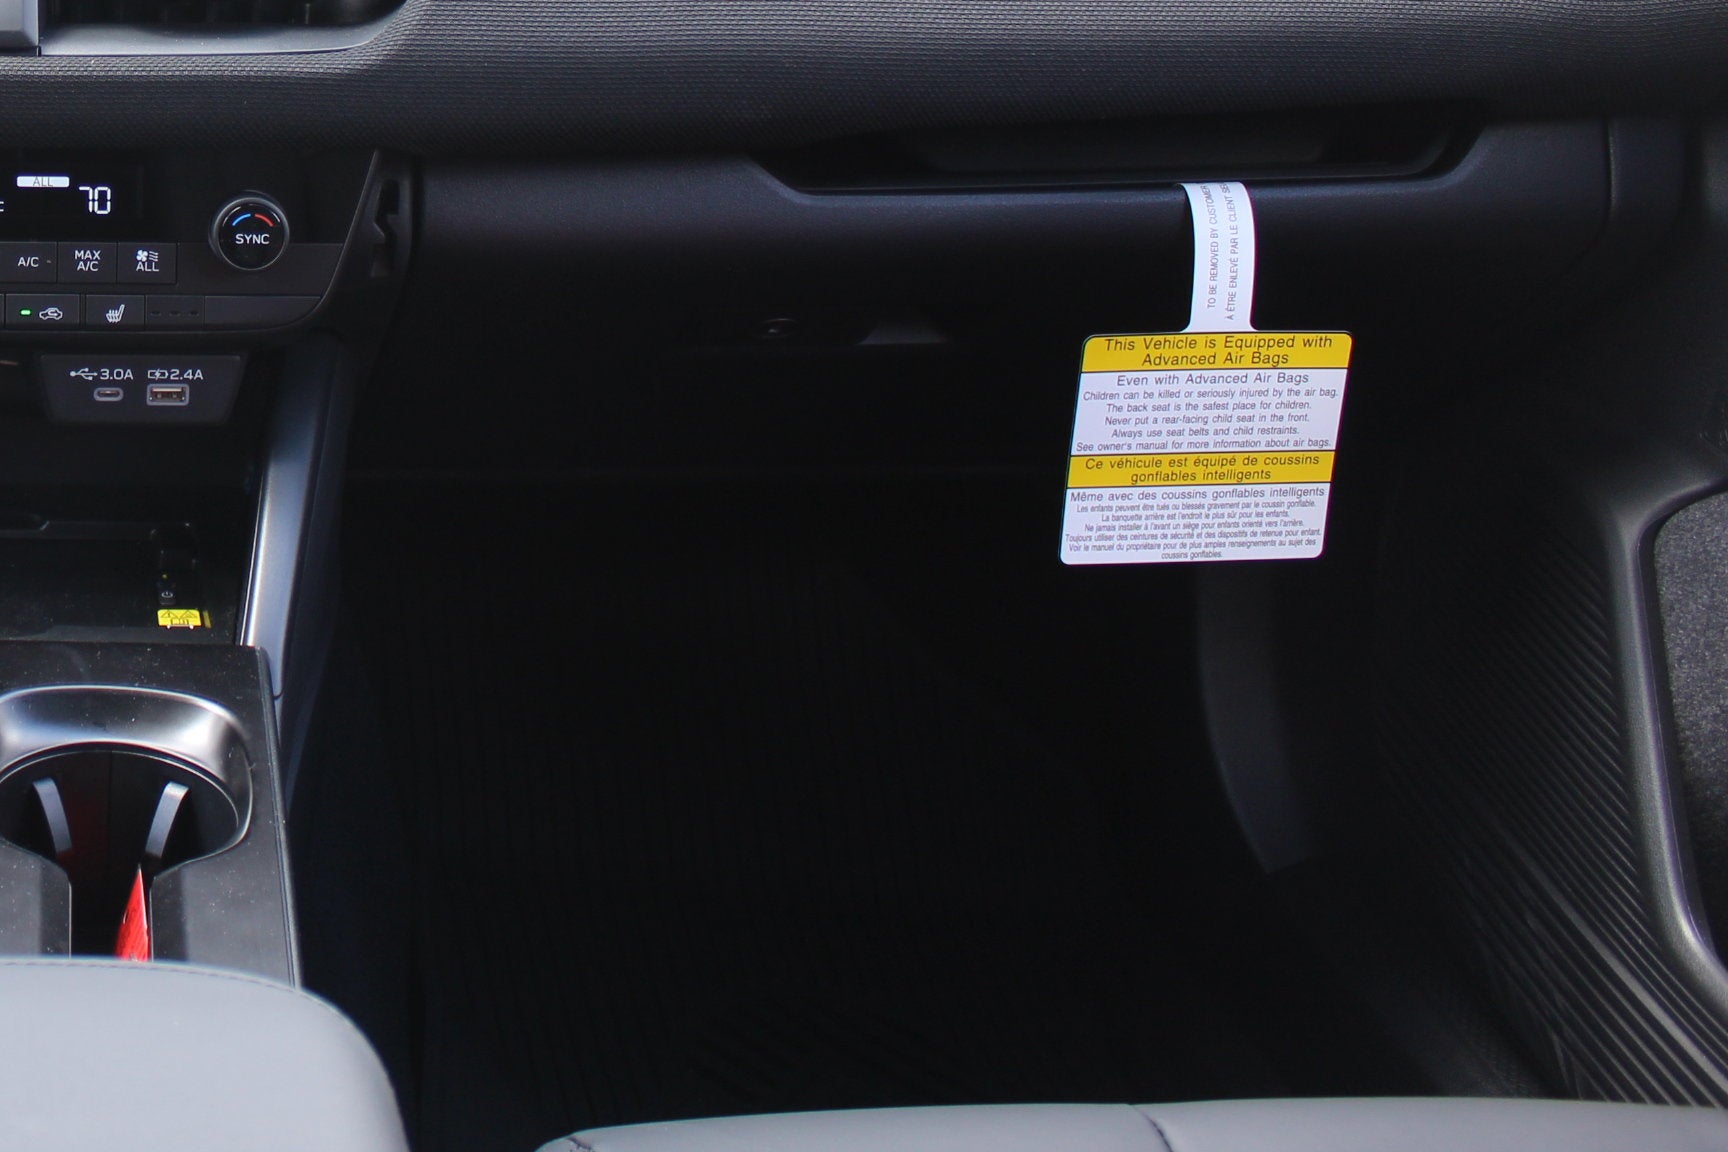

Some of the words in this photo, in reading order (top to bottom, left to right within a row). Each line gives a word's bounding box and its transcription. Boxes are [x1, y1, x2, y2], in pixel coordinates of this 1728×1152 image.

[32, 176, 54, 186] ALL
[78, 186, 111, 215] 70
[1224, 196, 1238, 222] CLIENT
[1208, 228, 1219, 238] BY
[1230, 224, 1238, 235] LE
[235, 234, 270, 245] SYNC
[1230, 238, 1240, 254] PAR
[74, 250, 101, 260] MAX
[1210, 241, 1219, 282] REMOVED
[18, 256, 39, 268] A/C
[76, 260, 98, 272] A/C
[136, 262, 160, 272] ALL
[1208, 284, 1217, 295] BE
[1207, 297, 1216, 309] TO
[1105, 338, 1135, 350] This
[1144, 337, 1197, 349] Vehicle
[1205, 337, 1216, 349] is
[1224, 336, 1295, 351] Equipped
[1303, 335, 1332, 348] with
[1142, 353, 1216, 366] Advanced
[1223, 352, 1245, 364] Air
[1251, 352, 1288, 367] Bags
[100, 368, 134, 380] 3.0A
[170, 368, 204, 380] 2.4A
[1117, 375, 1148, 386] Even
[1155, 374, 1179, 385] with
[1185, 373, 1248, 384] Advanced
[1254, 372, 1272, 383] Air
[1277, 372, 1309, 385] Bags
[1083, 391, 1120, 400] Children
[1123, 392, 1139, 400] can
[1142, 390, 1154, 399] be
[1158, 389, 1181, 399] killed
[1197, 388, 1236, 400] seriously
[1239, 388, 1269, 399] injured
[1272, 387, 1284, 399] by
[1287, 388, 1301, 397] the
[1304, 387, 1316, 396] air
[1107, 403, 1123, 412] The
[1127, 403, 1148, 412] back
[1151, 402, 1170, 412] seat
[1174, 402, 1181, 411] is
[1185, 402, 1199, 411] the
[1203, 401, 1229, 411] safest
[1232, 401, 1256, 412] place
[1260, 400, 1272, 410] for
[1105, 416, 1132, 425] Never
[1135, 416, 1149, 427] put
[1162, 414, 1209, 425] rear-facing
[1212, 414, 1233, 423] child
[1236, 414, 1257, 423] seat
[1258, 413, 1266, 423] in
[1270, 413, 1284, 422] the
[1111, 429, 1143, 439] Always
[1166, 428, 1186, 437] seat
[1189, 427, 1209, 436] belts
[1213, 426, 1230, 436] and
[1232, 426, 1254, 436] child
[1076, 442, 1094, 451] See
[1098, 442, 1132, 451] owner's
[1136, 440, 1168, 450] manual
[1172, 440, 1184, 449] for
[1187, 441, 1210, 449] more
[1213, 439, 1261, 448] information
[1265, 438, 1291, 447] about
[1293, 438, 1305, 447] air
[1086, 458, 1103, 469] Ce
[1110, 457, 1162, 468] véhicule
[1169, 457, 1188, 467] est
[1194, 456, 1236, 469] équipé
[1243, 455, 1258, 466] de
[1264, 454, 1319, 465] coussins
[1131, 471, 1196, 485] gonflables
[1203, 469, 1271, 484] intelligents
[1071, 492, 1103, 502] Même
[1108, 493, 1134, 501] avec
[1138, 491, 1157, 500] des
[1161, 490, 1207, 500] coussins
[1212, 488, 1265, 501] gonflables
[1270, 487, 1325, 500] intelligents
